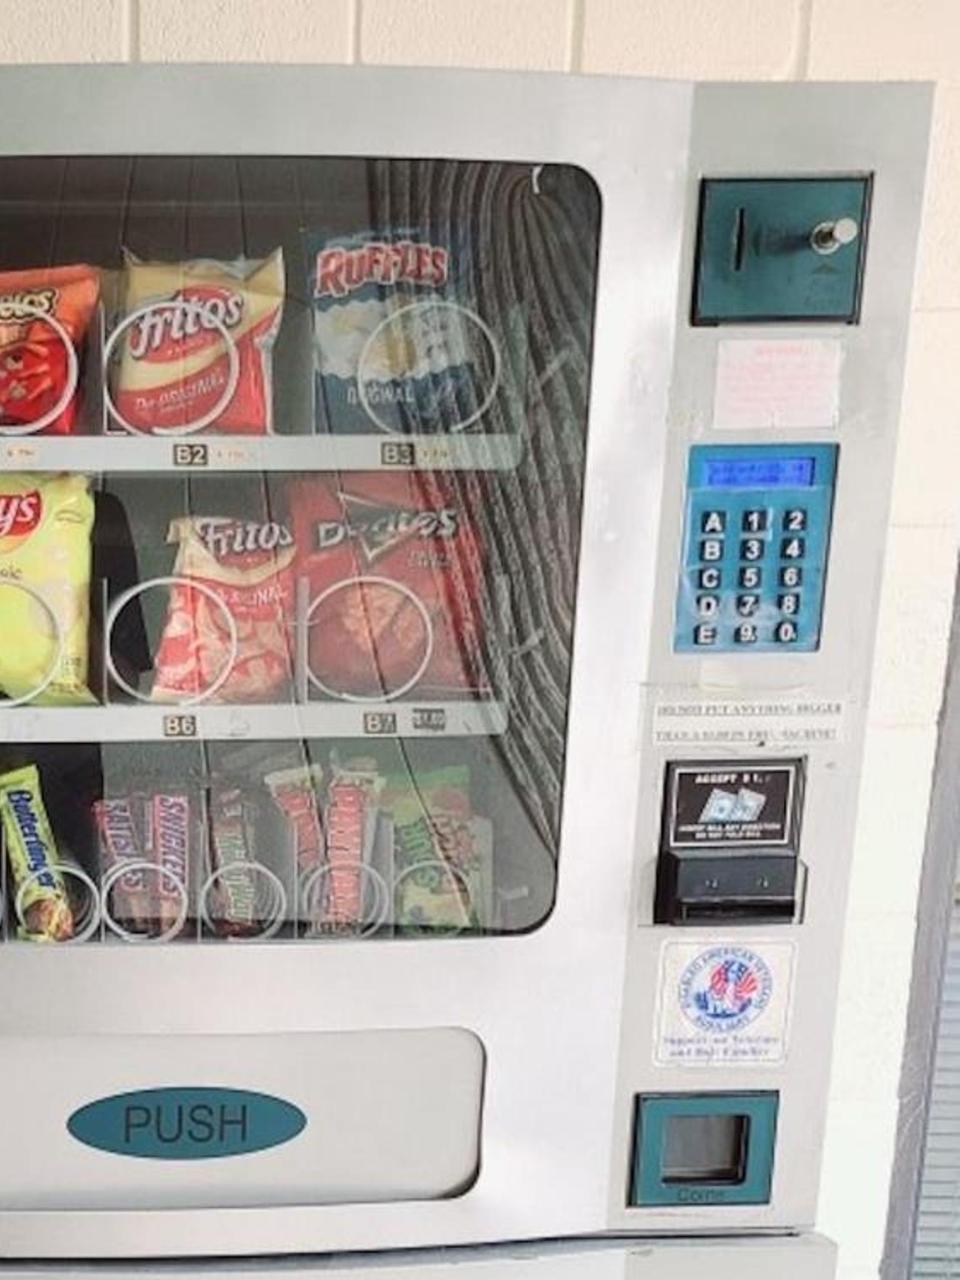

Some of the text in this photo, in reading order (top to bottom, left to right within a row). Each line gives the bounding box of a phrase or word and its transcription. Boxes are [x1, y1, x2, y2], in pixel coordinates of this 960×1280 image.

[315, 242, 448, 298] RUFFLES
[176, 446, 207, 463] B2
[200, 517, 293, 556] Fritos
[166, 717, 196, 736] B6
[7, 789, 56, 888] Butterfinger
[159, 794, 186, 898] SNICKERS
[123, 1103, 248, 1144] PUSH
